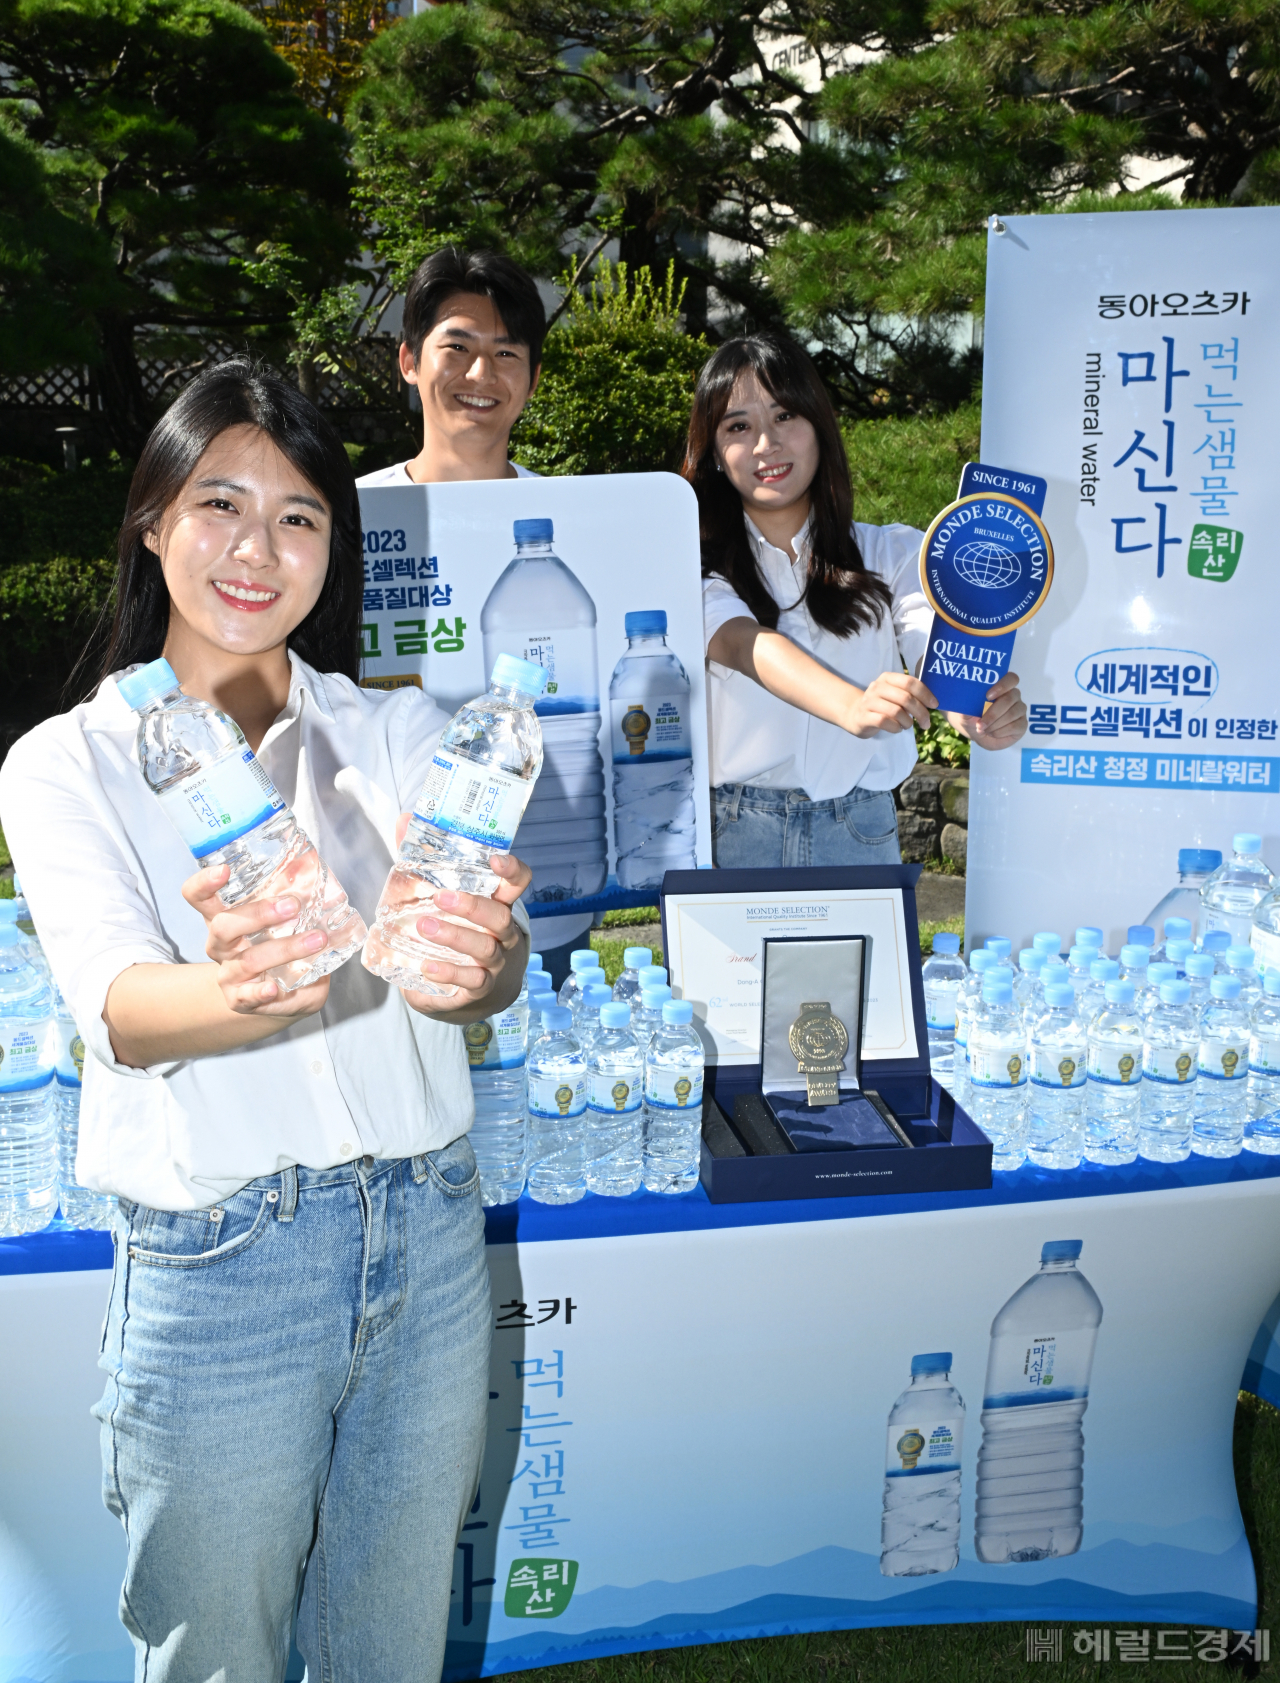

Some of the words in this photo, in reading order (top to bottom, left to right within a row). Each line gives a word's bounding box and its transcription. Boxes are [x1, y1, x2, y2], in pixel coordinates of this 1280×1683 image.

[1098, 291, 1250, 319] 동아오츠카
[1082, 353, 1106, 435] mineral
[1189, 337, 1243, 516] 먹는샘물
[1080, 443, 1099, 506] water
[1111, 336, 1190, 578] 마신다
[972, 470, 1009, 489] SINCE
[1012, 480, 1036, 495] 1961
[931, 504, 982, 560] MONDE
[987, 503, 1044, 581] SELECTION
[974, 527, 1014, 542] BRUXELLES
[931, 569, 968, 621] INTERNATIONAL
[970, 615, 1002, 625] QUALITY
[1004, 589, 1035, 620] INSTITUTE
[394, 616, 467, 656] 금상
[933, 639, 1007, 668] QUALITY
[928, 658, 999, 685] AWARD
[1086, 663, 1212, 697] 세계적인
[1214, 718, 1278, 740] 인정한
[1030, 754, 1098, 779] 속리산
[1103, 756, 1148, 781] 청정
[1156, 758, 1271, 786] 미네랄워터
[192, 790, 221, 828] 마신다
[478, 786, 499, 826] 마신다
[746, 907, 779, 916] MONDE
[781, 905, 828, 914] SELECTION
[815, 1170, 893, 1179] www.monde-selection.com
[1029, 1344, 1047, 1386] 마신다
[504, 1349, 573, 1549] 먹는샘물
